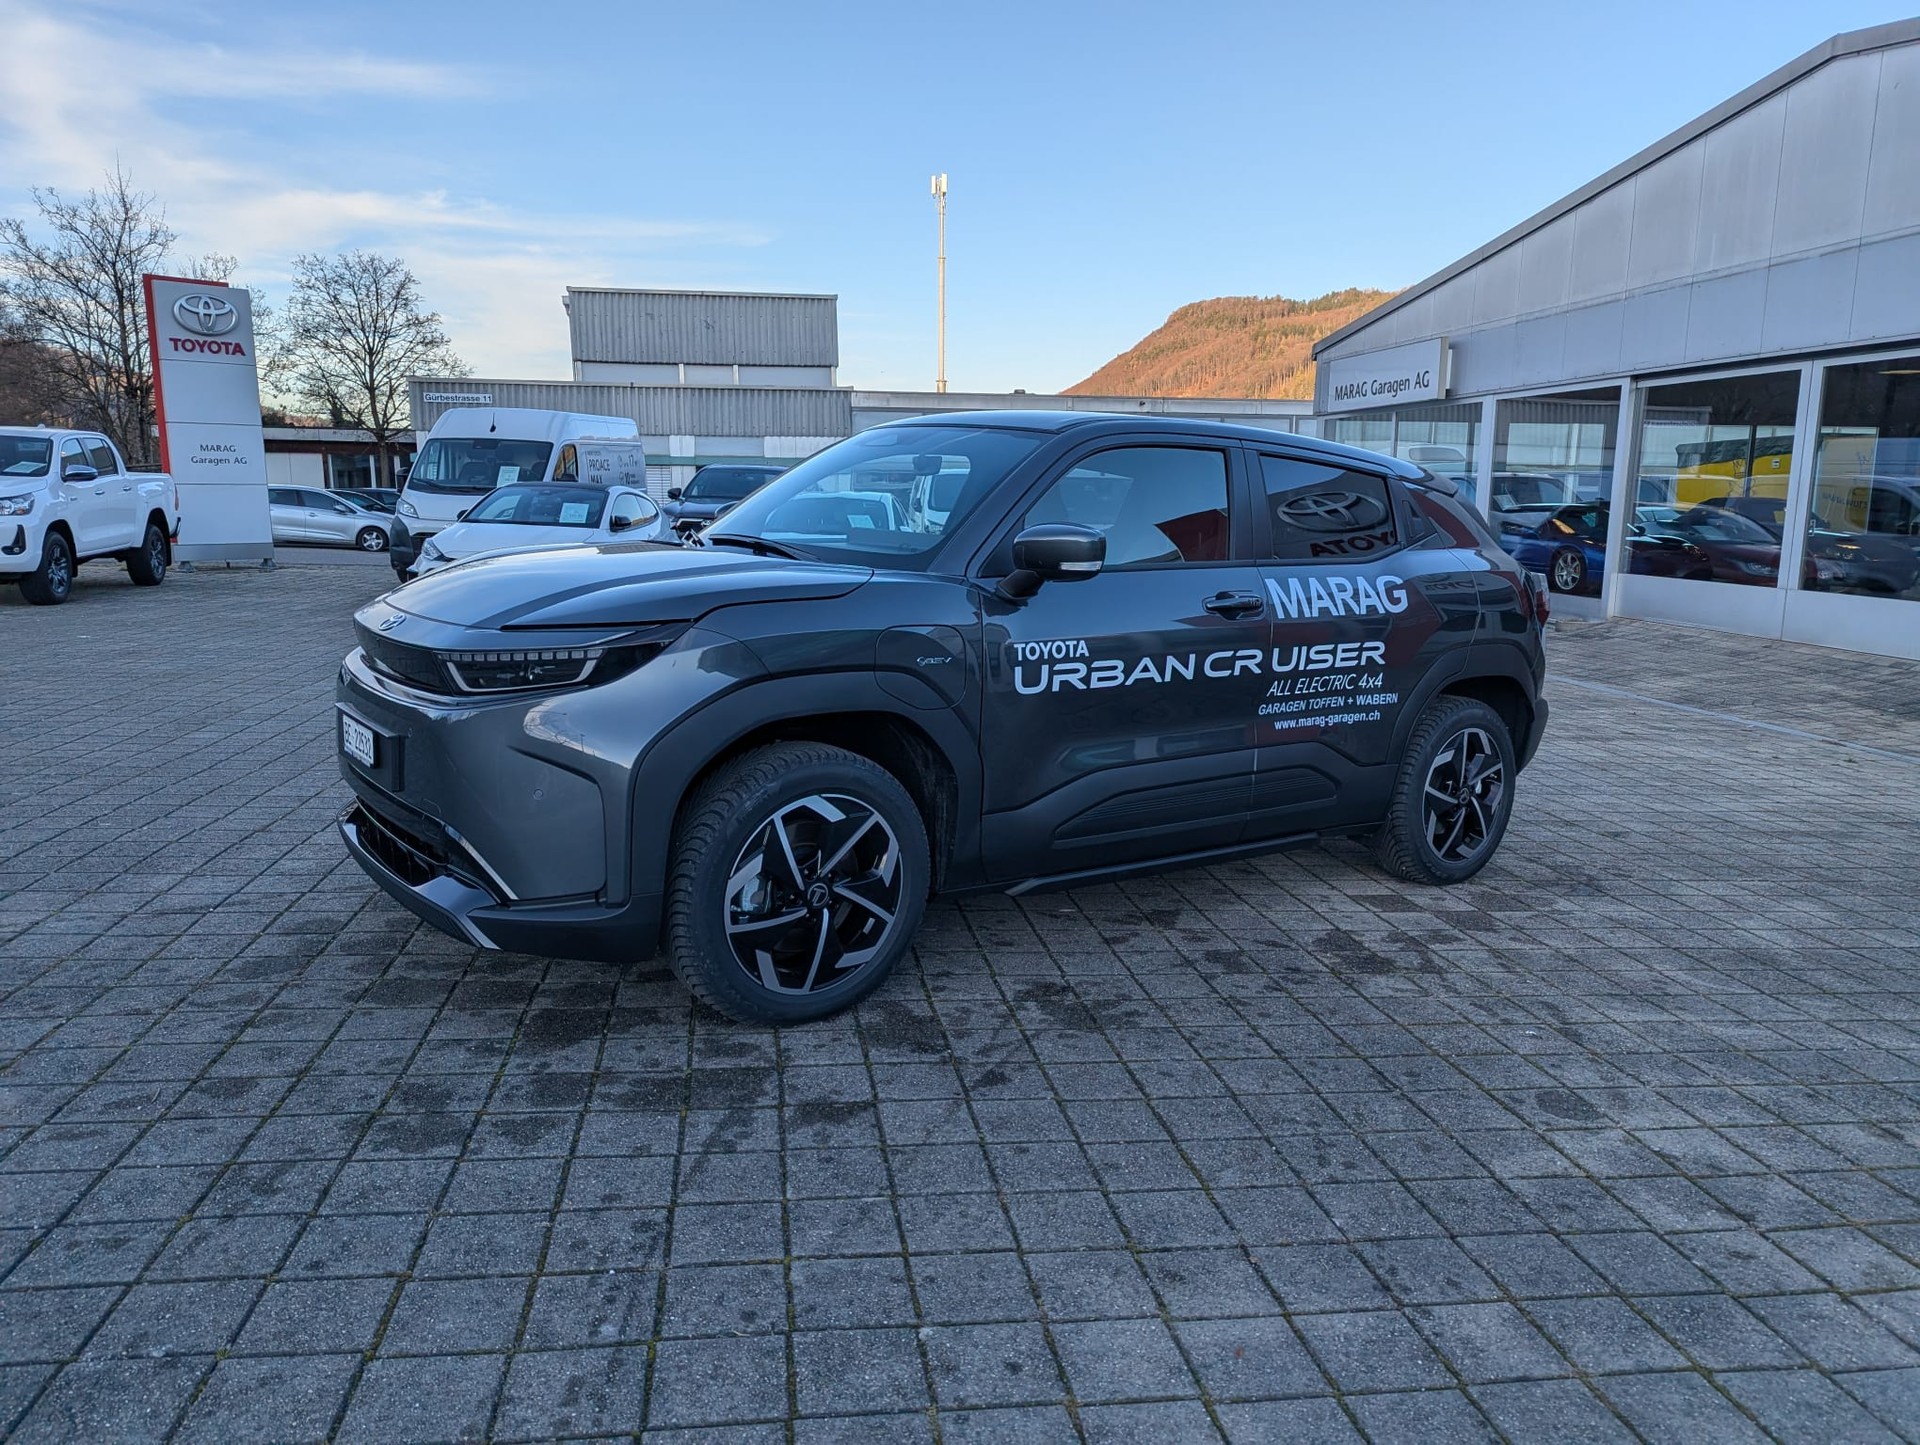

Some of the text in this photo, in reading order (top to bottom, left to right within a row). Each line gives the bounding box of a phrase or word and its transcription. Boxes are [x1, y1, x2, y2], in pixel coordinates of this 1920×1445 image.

[168, 337, 247, 356] TOYOTA
[1334, 370, 1430, 401] MARAG Garagen AG
[424, 393, 481, 402] Gürbestrasse
[199, 444, 237, 453] MARAG
[190, 455, 248, 467] Garagen AG
[1263, 574, 1409, 620] MARAG
[1013, 639, 1090, 662] TOYOTA
[1013, 653, 1197, 695] URBAN
[1266, 672, 1384, 697] ALL ELECTRIC 4x4
[1258, 692, 1399, 716] GARAGEN TOFFEN + WABERN
[1274, 709, 1381, 730] www.marag-garagen.ch
